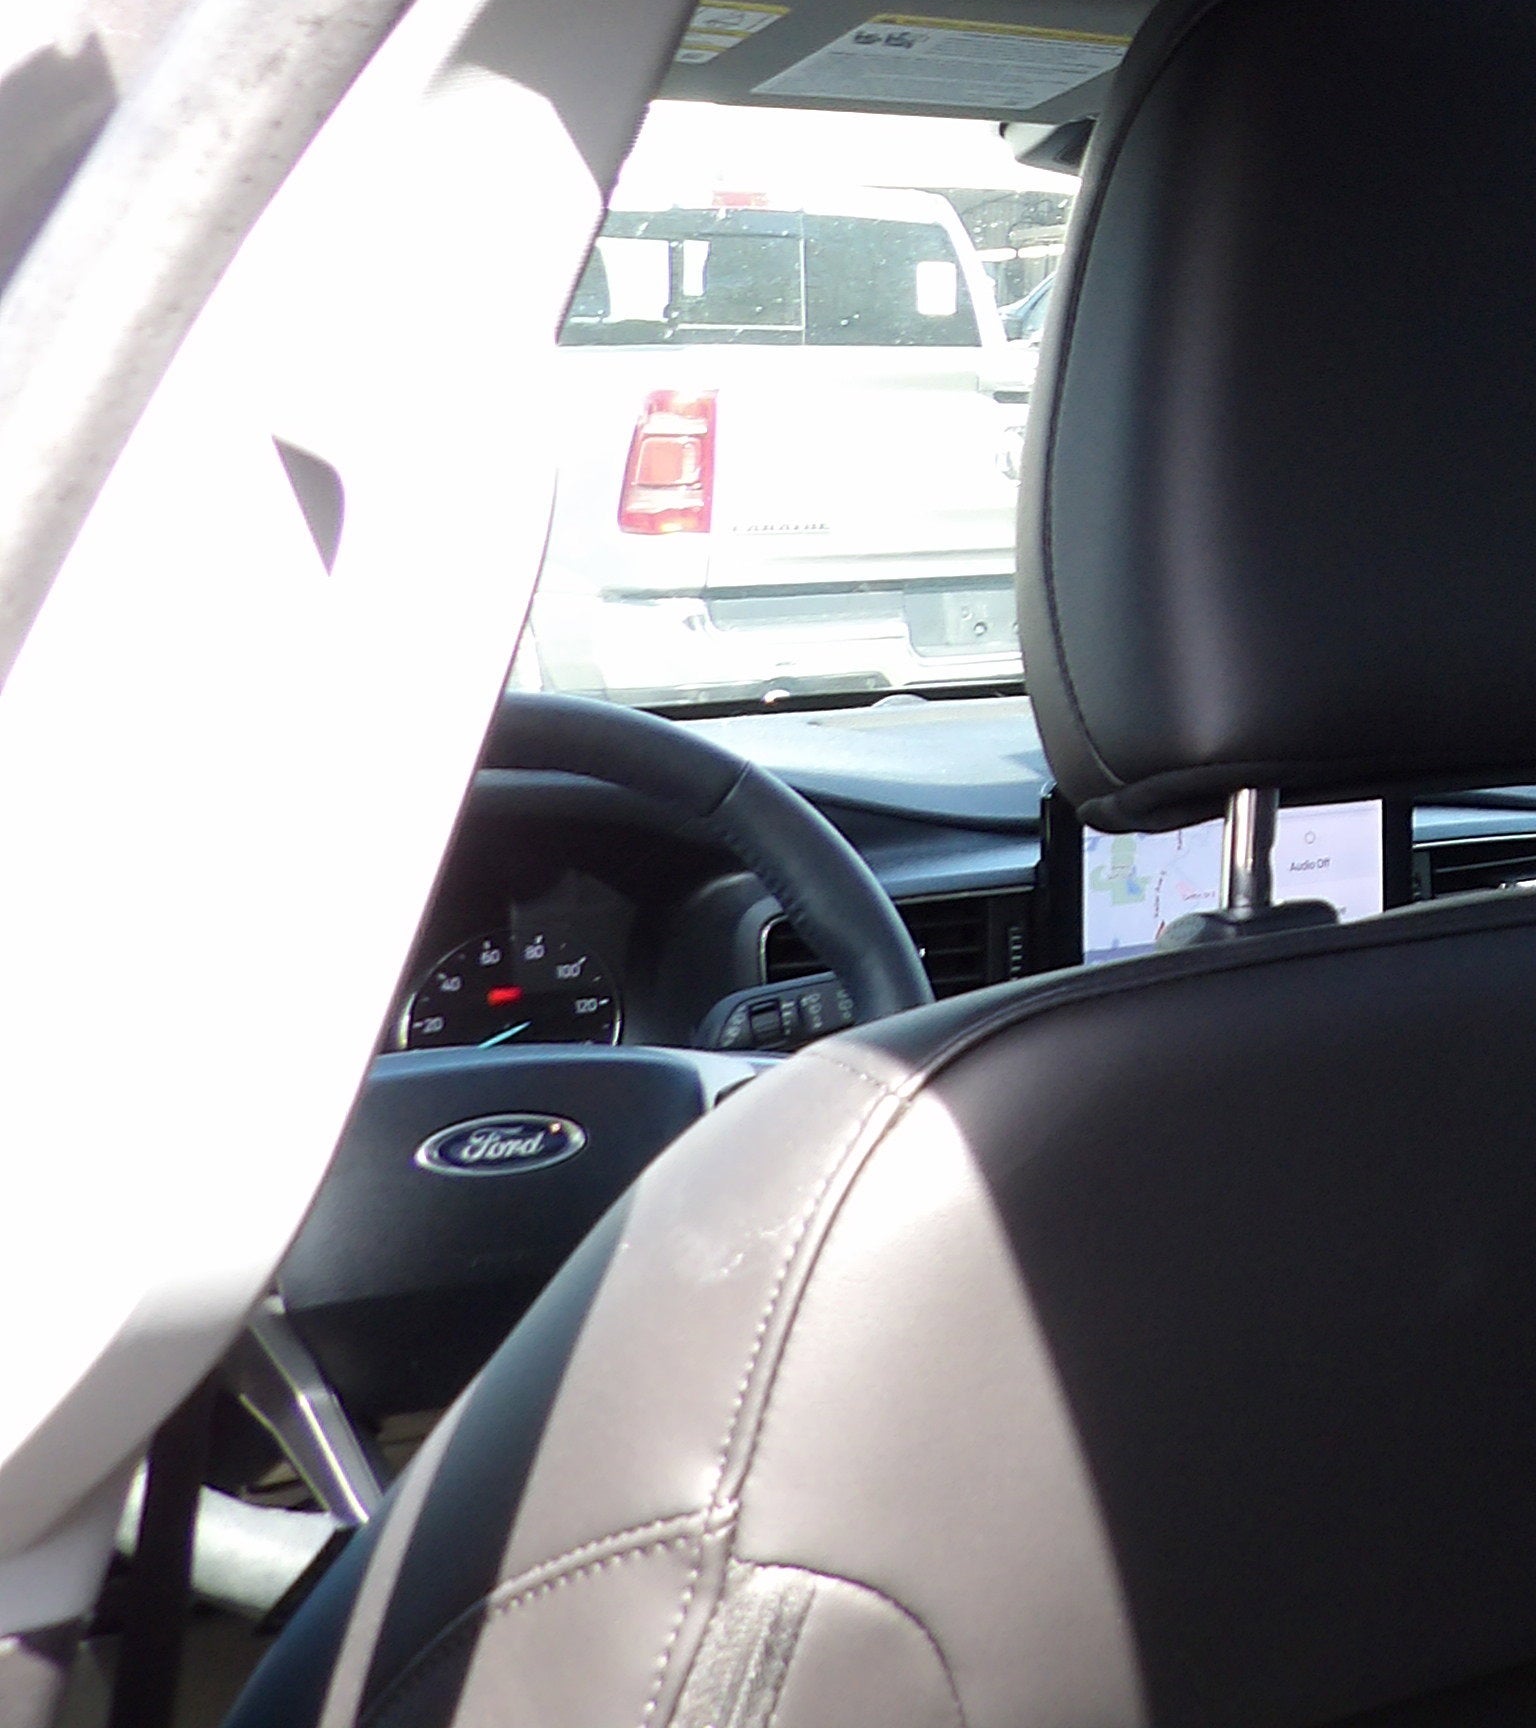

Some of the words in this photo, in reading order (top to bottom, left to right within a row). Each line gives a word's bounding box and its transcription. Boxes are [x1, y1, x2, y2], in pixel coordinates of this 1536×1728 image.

[480, 949, 501, 965] 60
[524, 944, 546, 960] 80
[556, 963, 581, 979] 100
[440, 976, 462, 991] 40
[575, 998, 598, 1014] 120
[422, 1016, 444, 1033] 20
[459, 1125, 547, 1163] Ford
